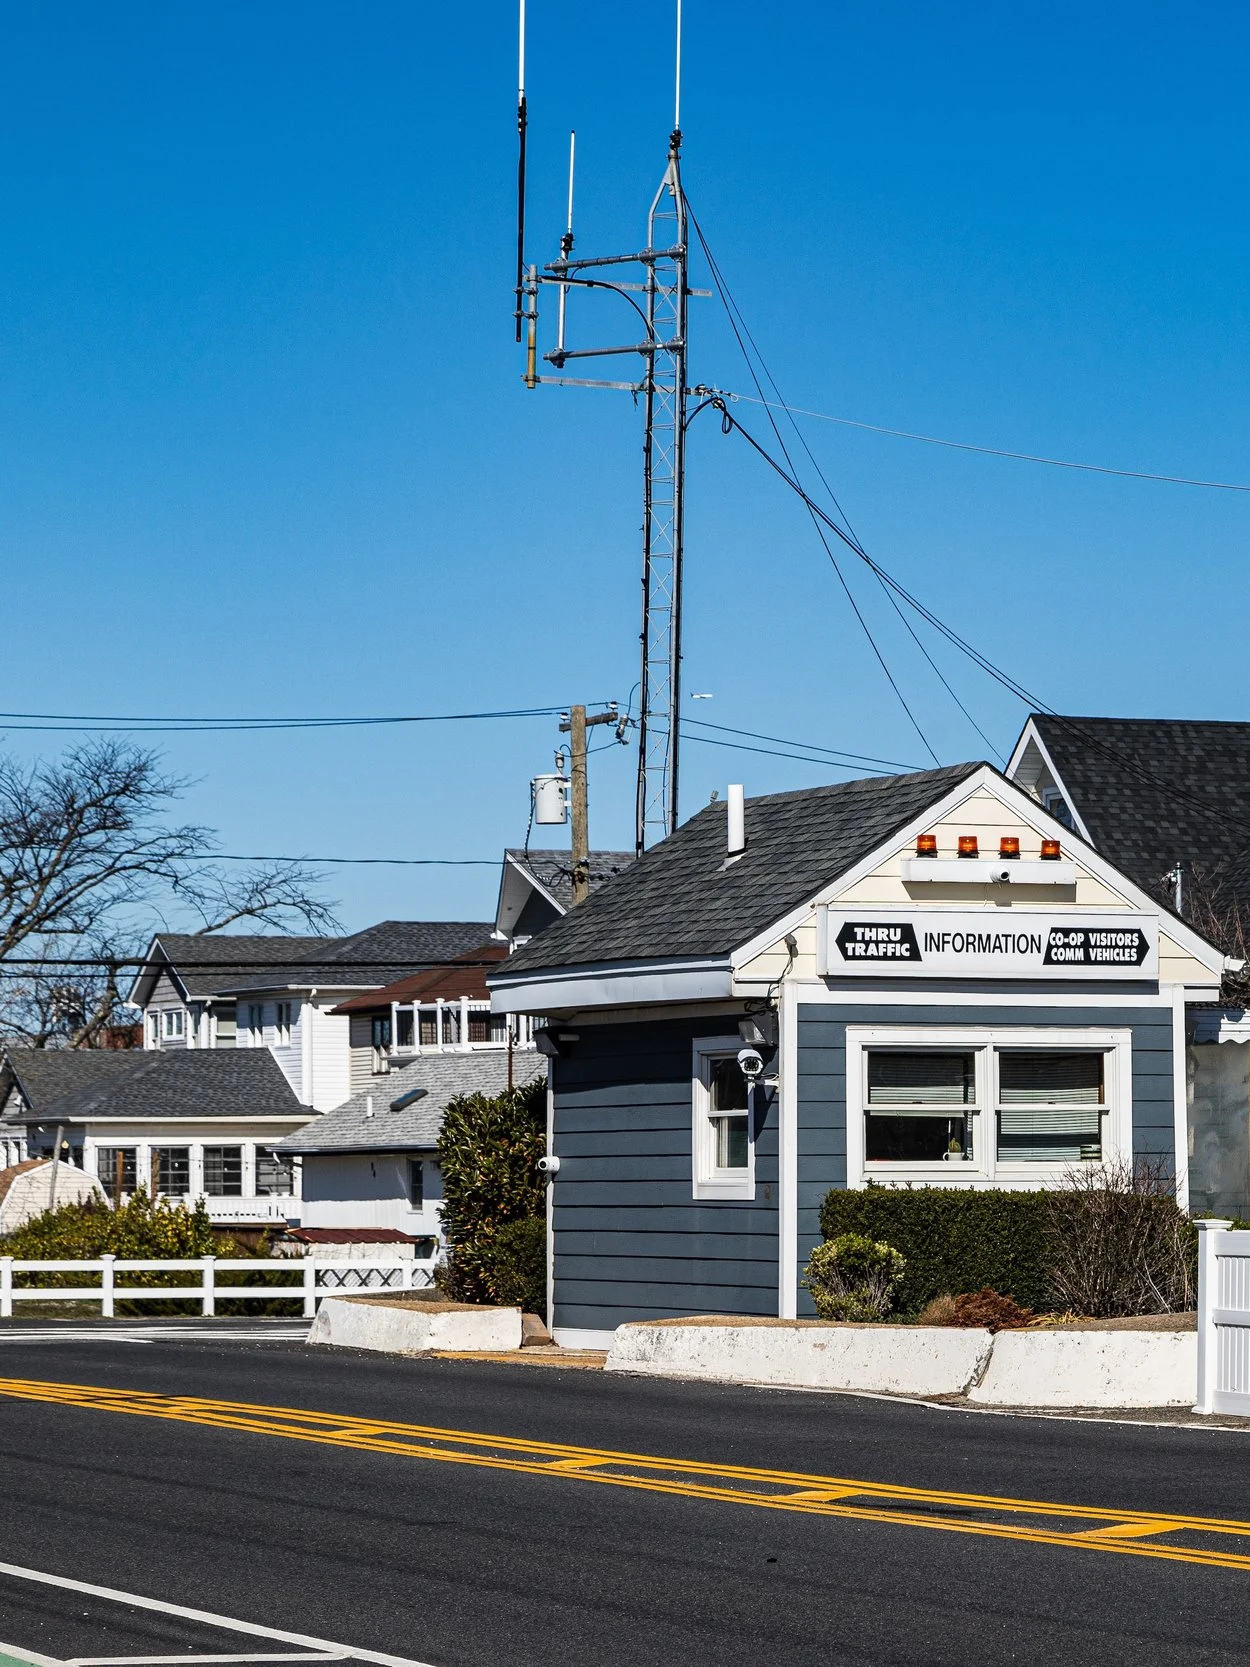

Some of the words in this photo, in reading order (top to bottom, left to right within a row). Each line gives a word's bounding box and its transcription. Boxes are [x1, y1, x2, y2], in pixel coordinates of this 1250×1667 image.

[854, 927, 901, 941] THRU
[1049, 933, 1084, 947] CO-OP
[1089, 933, 1139, 947] VISITORS
[845, 943, 910, 957] TRAFFIC
[924, 932, 1042, 954] INFORMATION
[1050, 948, 1084, 961] COMM
[1089, 948, 1137, 962] VEHICLES
